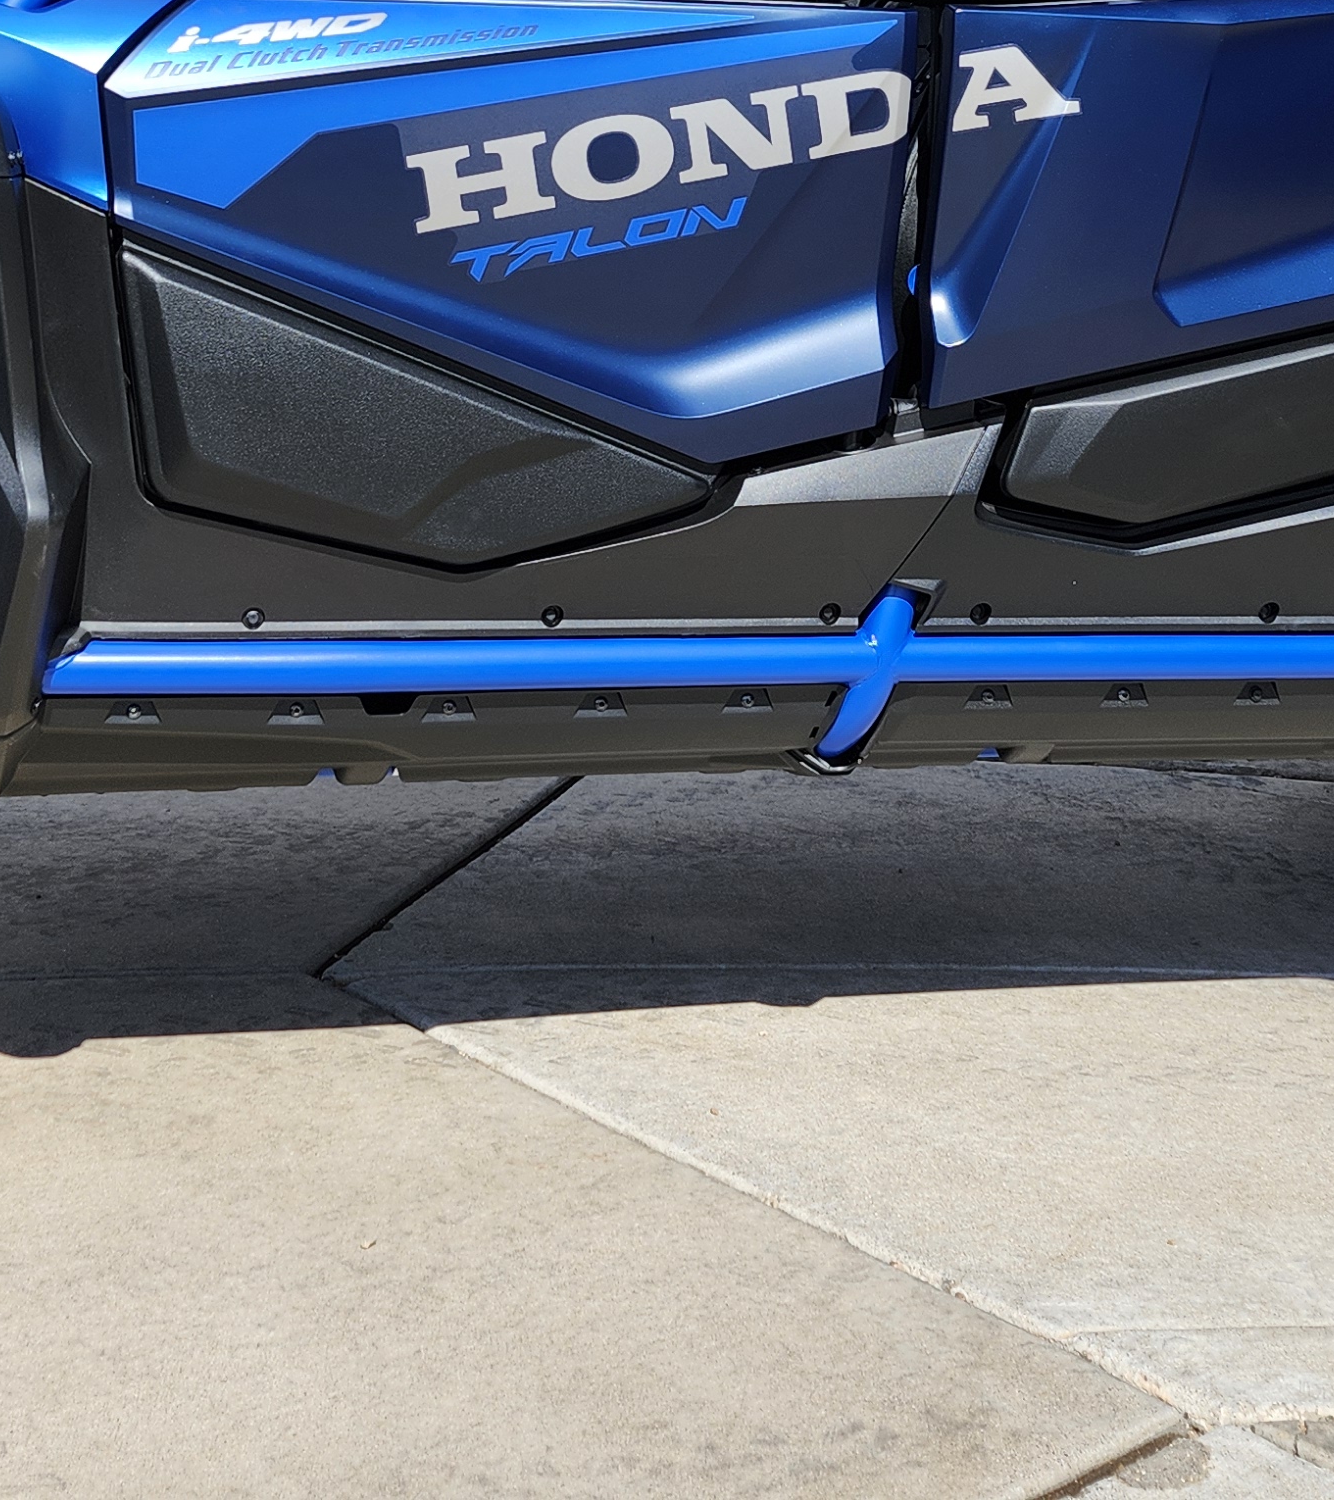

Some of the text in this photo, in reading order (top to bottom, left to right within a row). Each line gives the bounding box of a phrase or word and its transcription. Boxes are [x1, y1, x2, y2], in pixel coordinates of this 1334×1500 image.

[144, 24, 540, 79] Dual Clutch Transmission
[167, 12, 388, 54] i-4WD
[405, 43, 1080, 235] HONDA
[450, 196, 747, 283] TALON
